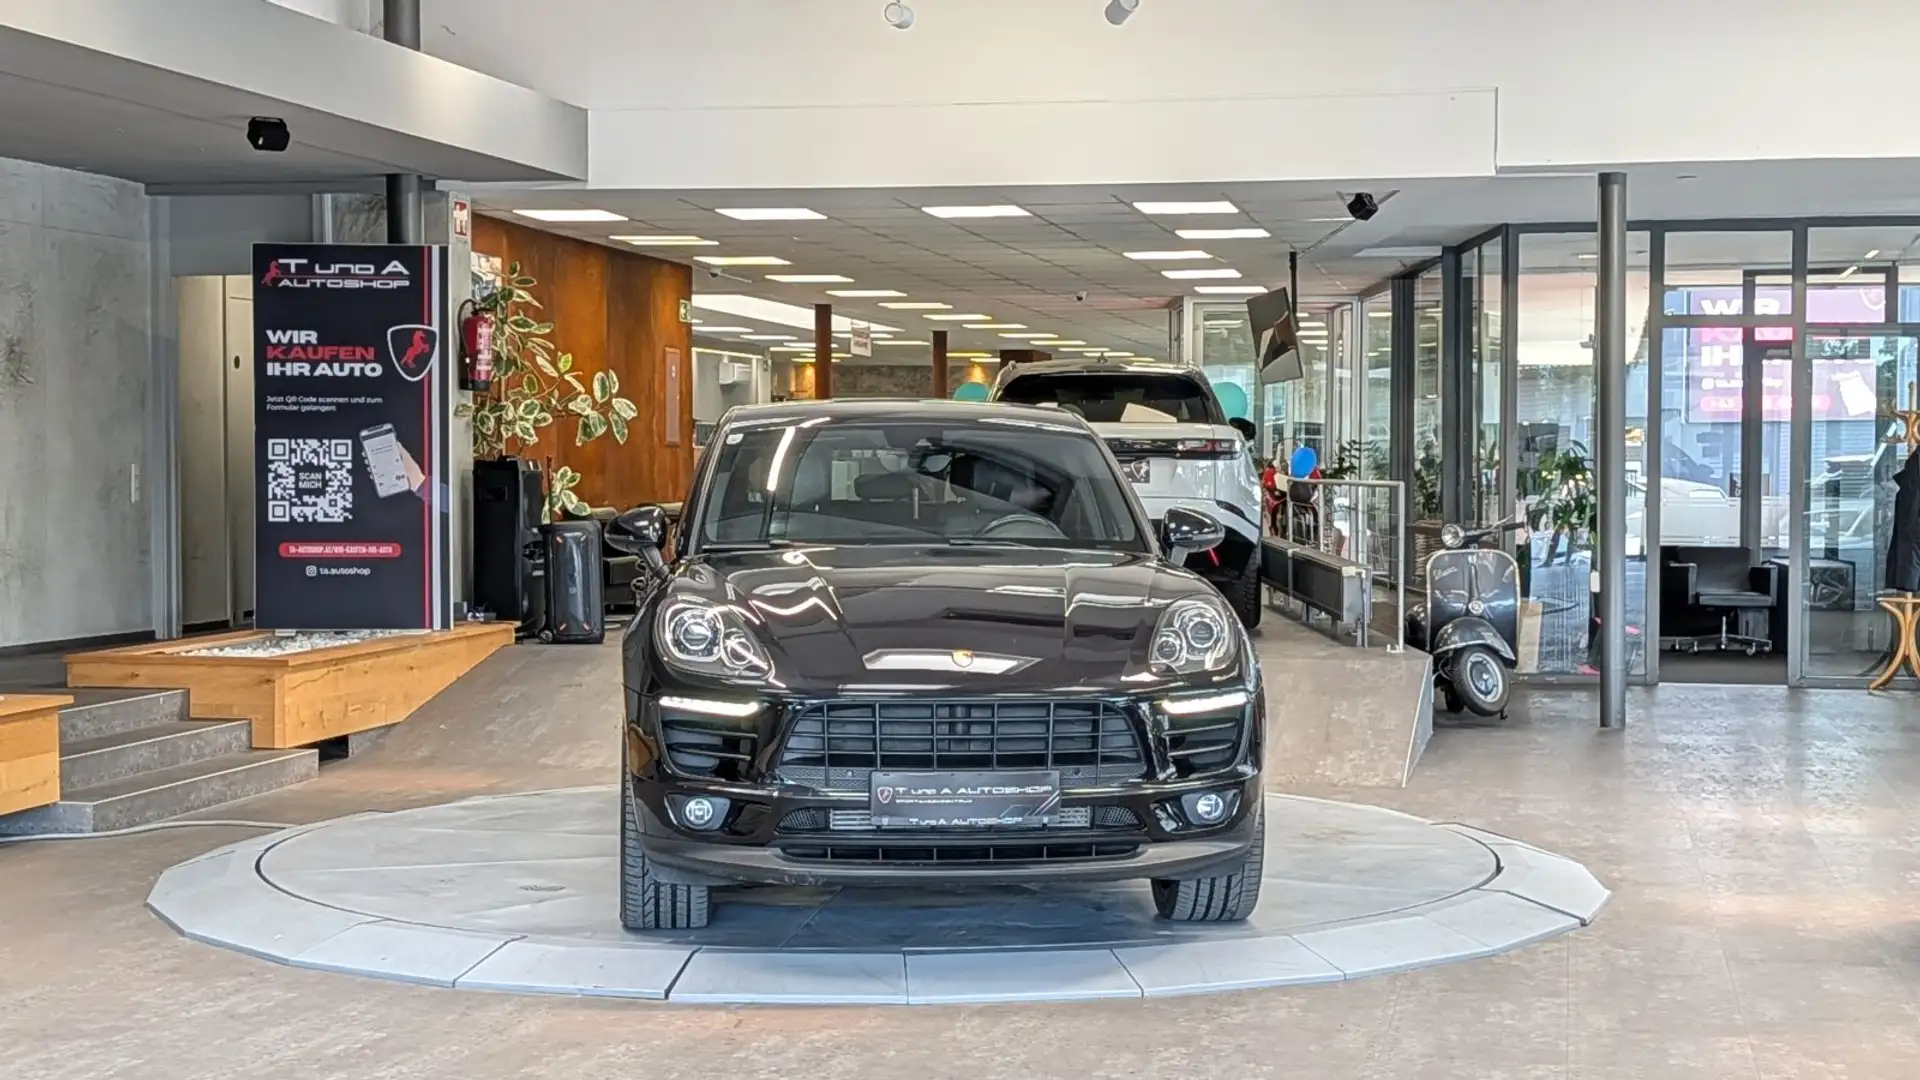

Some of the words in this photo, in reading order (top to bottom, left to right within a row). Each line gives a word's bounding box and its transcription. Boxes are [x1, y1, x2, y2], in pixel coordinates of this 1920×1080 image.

[278, 258, 308, 274] T
[380, 260, 410, 275] A
[278, 279, 410, 289] AUTOSHOP
[1701, 298, 1781, 316] WR
[266, 329, 318, 345] WIR
[266, 346, 375, 360] KAUFEN
[266, 362, 311, 378] IHR
[313, 362, 383, 378] AUTO
[266, 395, 284, 404] Jetzt
[285, 395, 298, 405] QR
[298, 395, 317, 404] Code
[318, 396, 350, 404] scannen
[351, 396, 365, 404] und
[266, 403, 299, 412] Formular
[298, 472, 323, 480] SCAN
[298, 480, 323, 489] MICH
[319, 565, 371, 576] ta.autoshop
[895, 786, 908, 795] T
[941, 786, 953, 795] A
[960, 785, 1053, 795] AUTOSHOP
[951, 816, 1023, 825] AUTOSHOP
